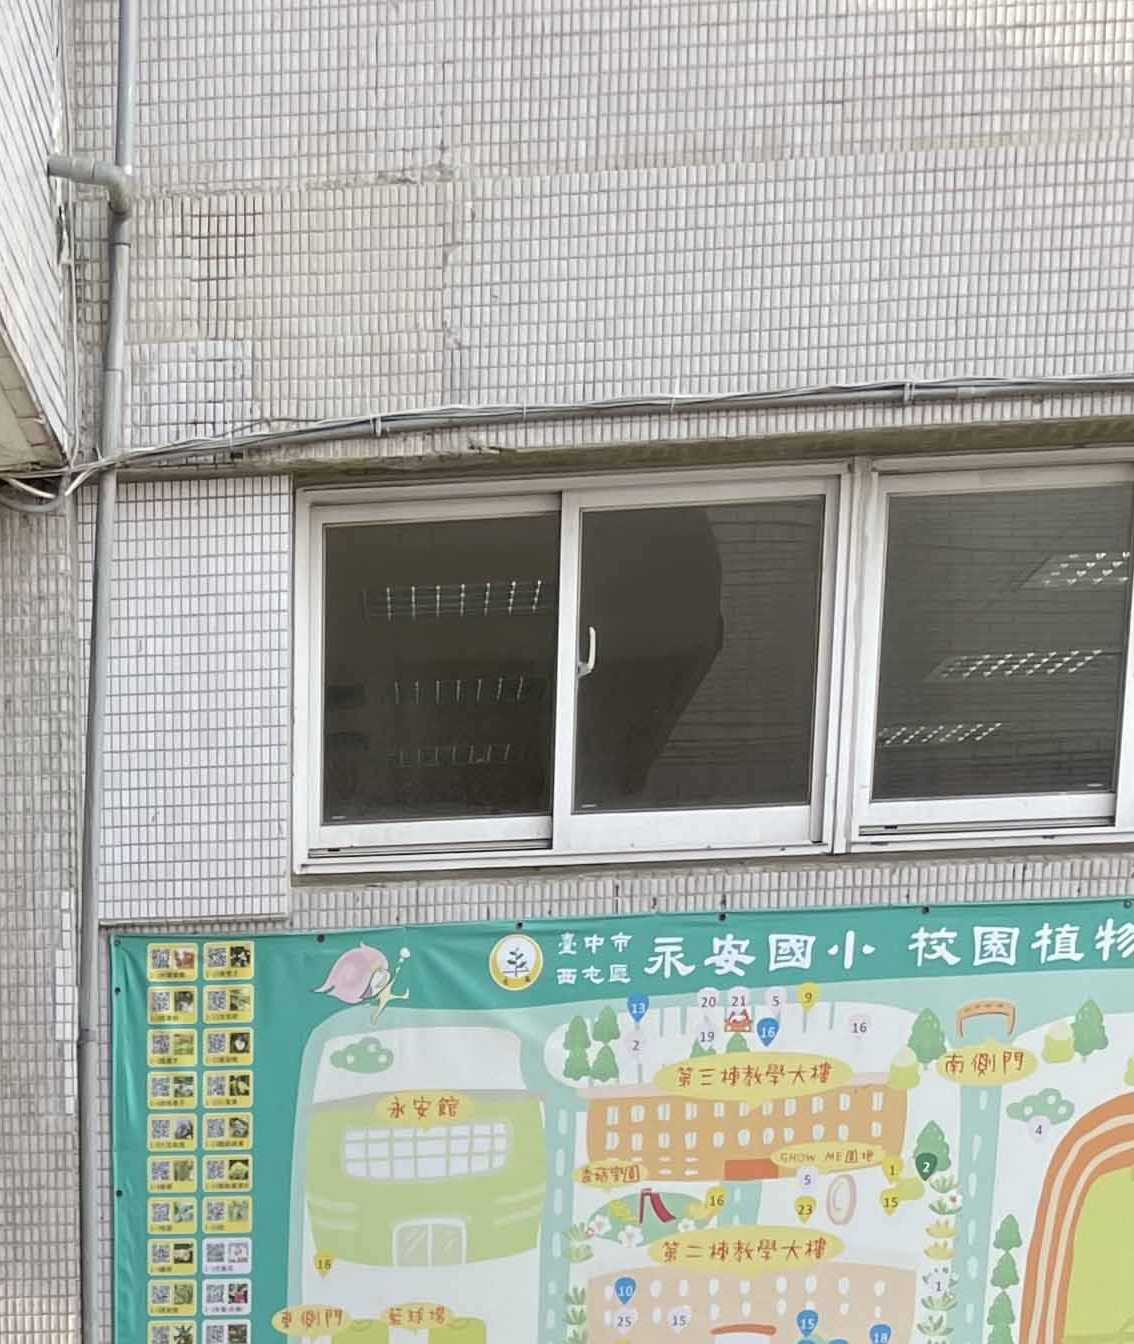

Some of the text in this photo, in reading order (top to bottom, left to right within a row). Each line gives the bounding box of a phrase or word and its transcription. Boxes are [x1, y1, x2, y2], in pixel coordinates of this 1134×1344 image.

[558, 932, 633, 955] 臺中市
[644, 918, 1134, 979] 永安國小 校園植物
[556, 964, 632, 985] 西屯區
[701, 997, 716, 1008] 20
[731, 996, 746, 1007] 21
[632, 1003, 646, 1014] 13
[761, 1026, 776, 1038] 16
[852, 1022, 867, 1034] 16
[700, 1031, 715, 1042] 19
[944, 1051, 1024, 1076] 南側門
[677, 1061, 832, 1087] 第三棟教學大樓
[387, 1095, 460, 1120] 永安館
[710, 1195, 724, 1207] 16
[884, 1196, 898, 1208] 15
[797, 1204, 812, 1215] 23
[663, 1237, 827, 1262] 第二棟教學大樓
[619, 1286, 633, 1297] 10
[617, 1316, 632, 1327] 25
[673, 1315, 686, 1327] 15
[801, 1318, 815, 1330] 15
[874, 1332, 888, 1344] 18
